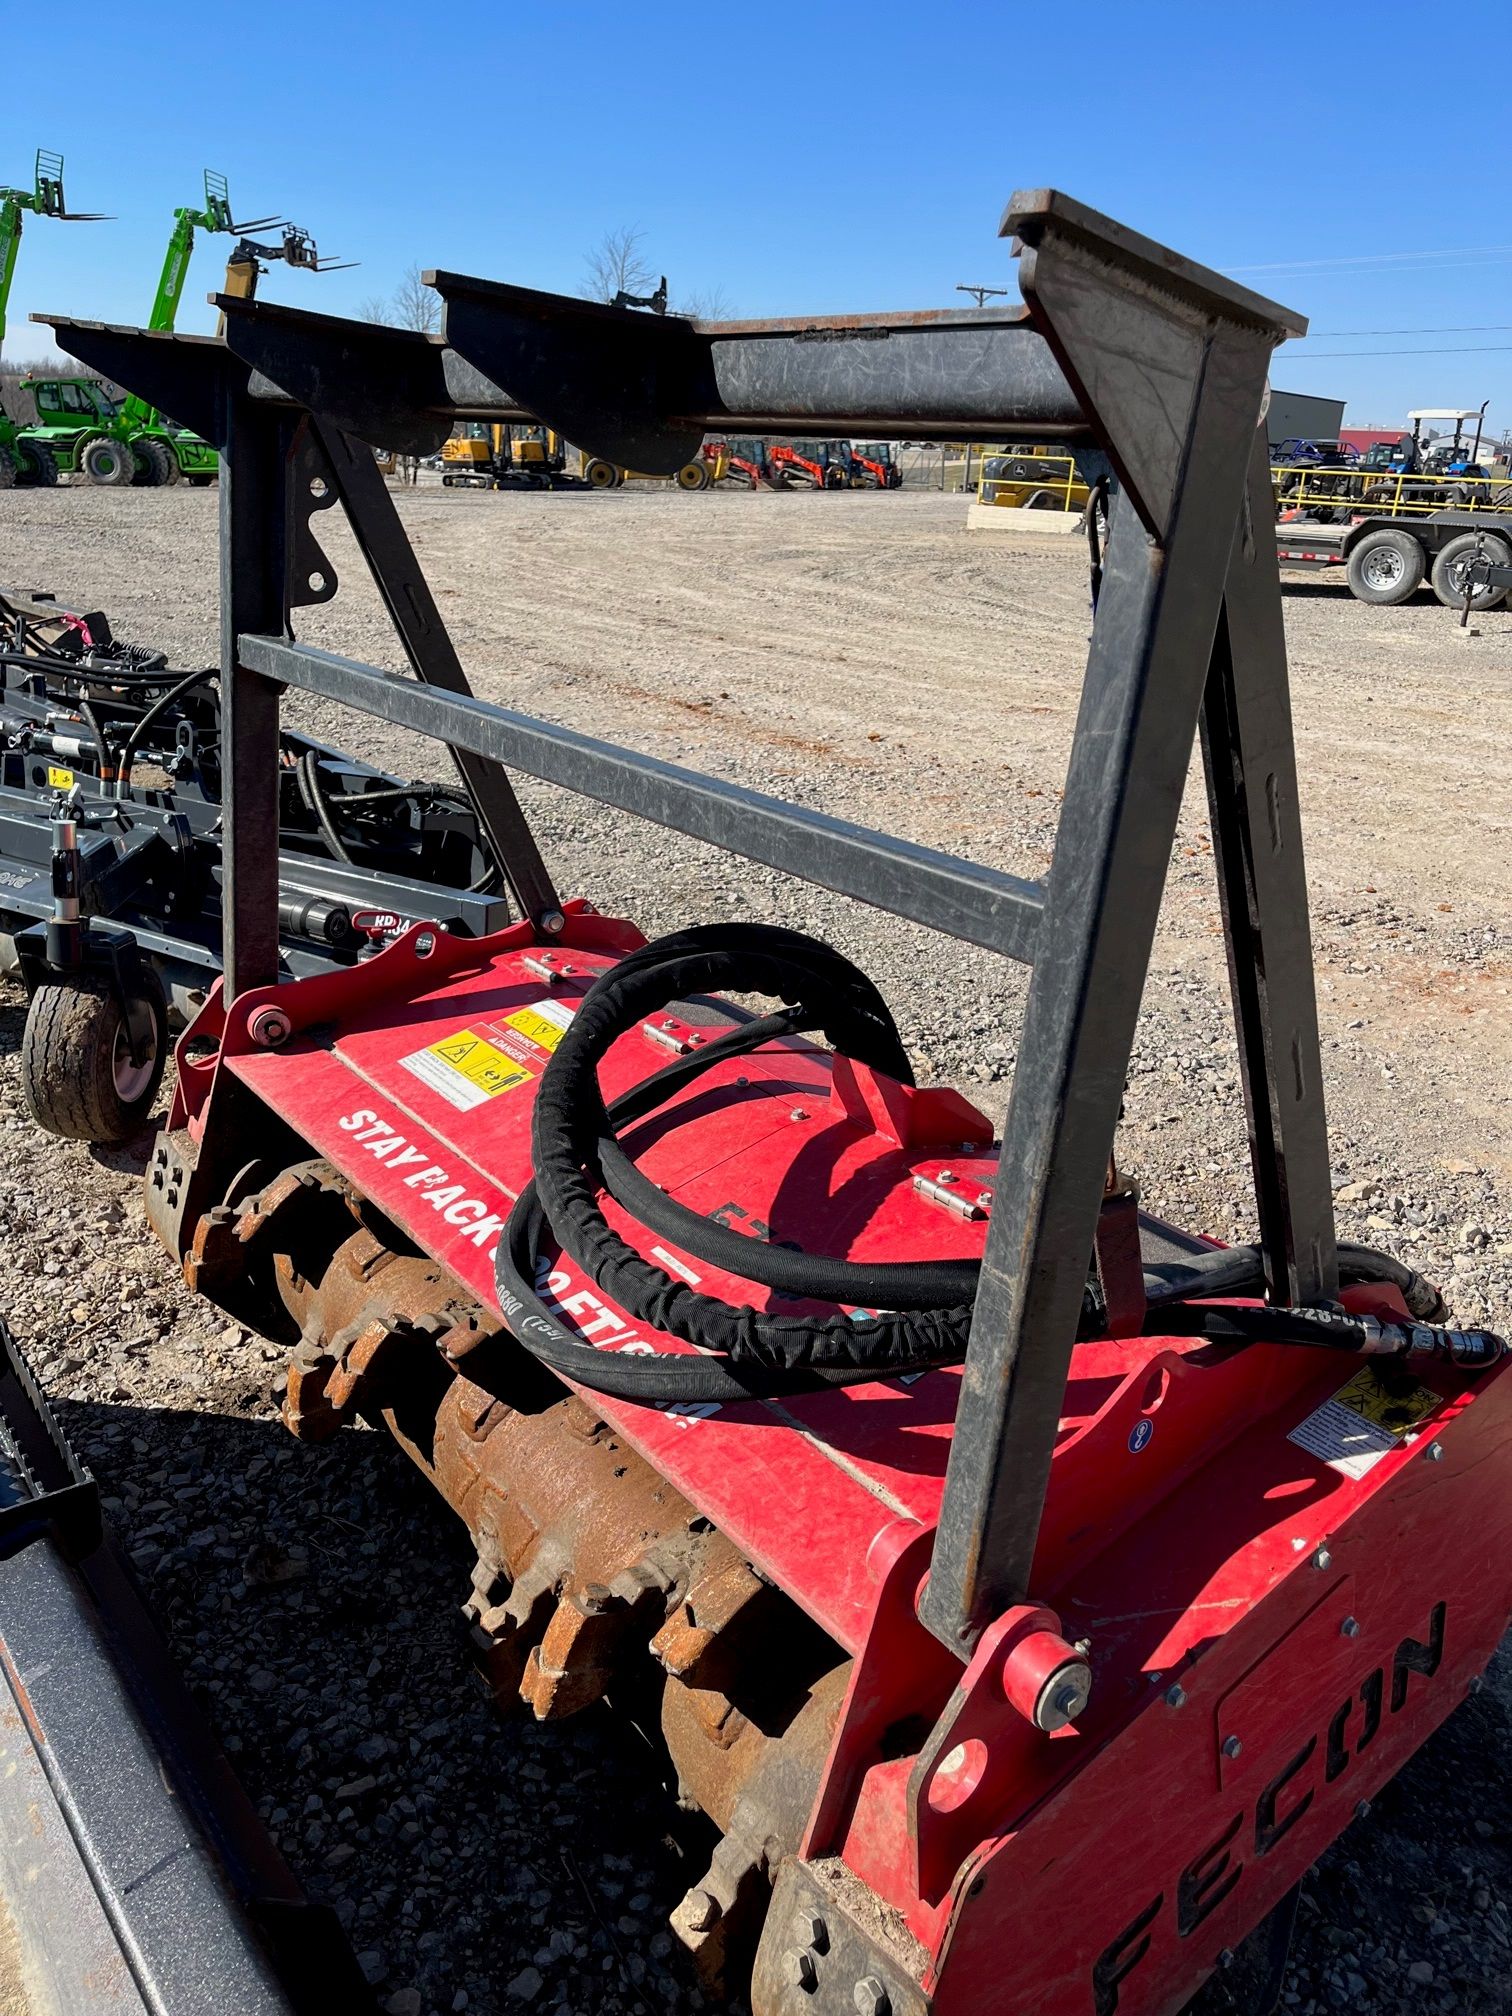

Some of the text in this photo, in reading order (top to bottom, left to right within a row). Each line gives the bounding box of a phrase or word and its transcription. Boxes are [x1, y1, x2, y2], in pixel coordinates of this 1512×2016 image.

[338, 1109, 429, 1169] STAY
[402, 1165, 506, 1247] BACK
[1092, 1600, 1447, 2016] FECON
